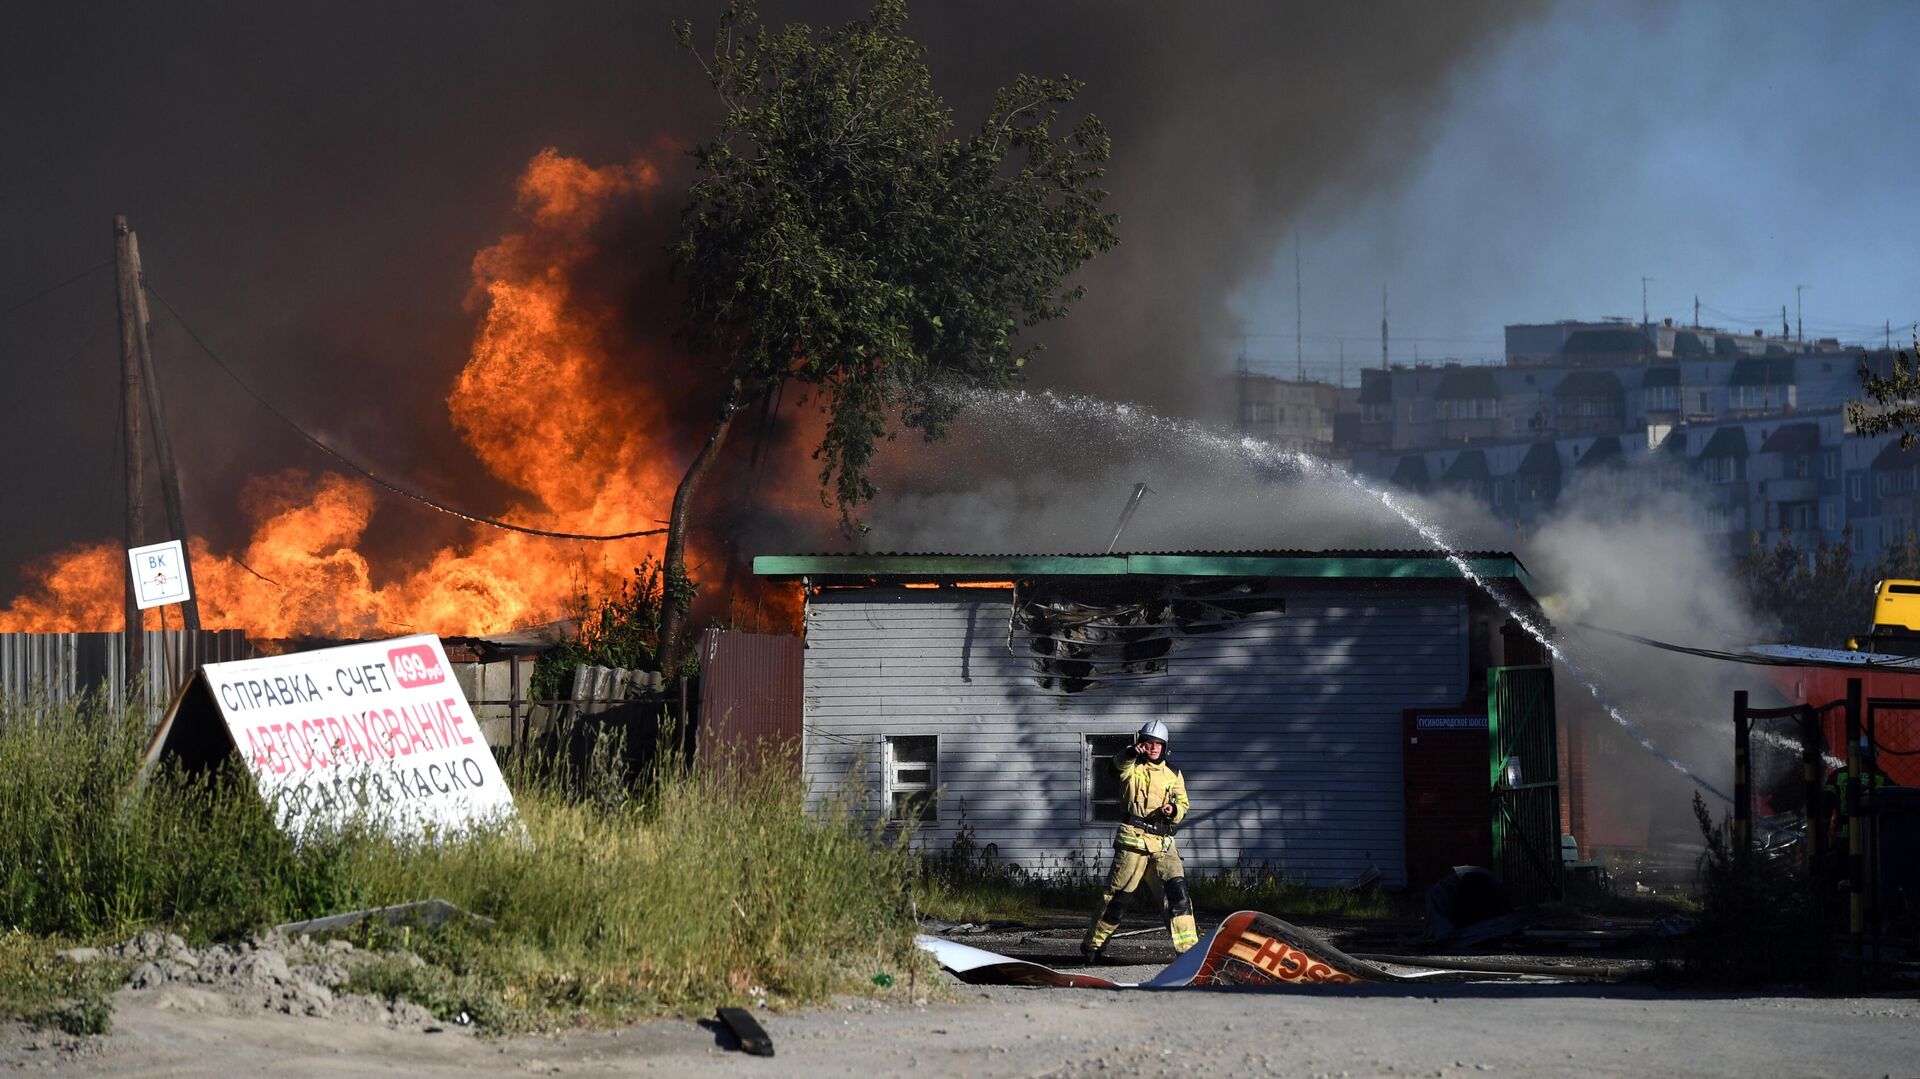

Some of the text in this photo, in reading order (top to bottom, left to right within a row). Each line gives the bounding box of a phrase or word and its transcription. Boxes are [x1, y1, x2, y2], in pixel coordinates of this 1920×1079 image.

[148, 554, 167, 569] ВК
[394, 653, 428, 682] 499
[221, 673, 324, 712] СПРАВКА
[336, 663, 393, 697] СЧЕТ
[246, 698, 474, 775] АВТОСТРАХОВАНИЕ
[1418, 718, 1488, 728] ГУСИНОБРОДСКОЕ ШОССЕ
[373, 773, 394, 803] &
[392, 757, 485, 801] КАСКО
